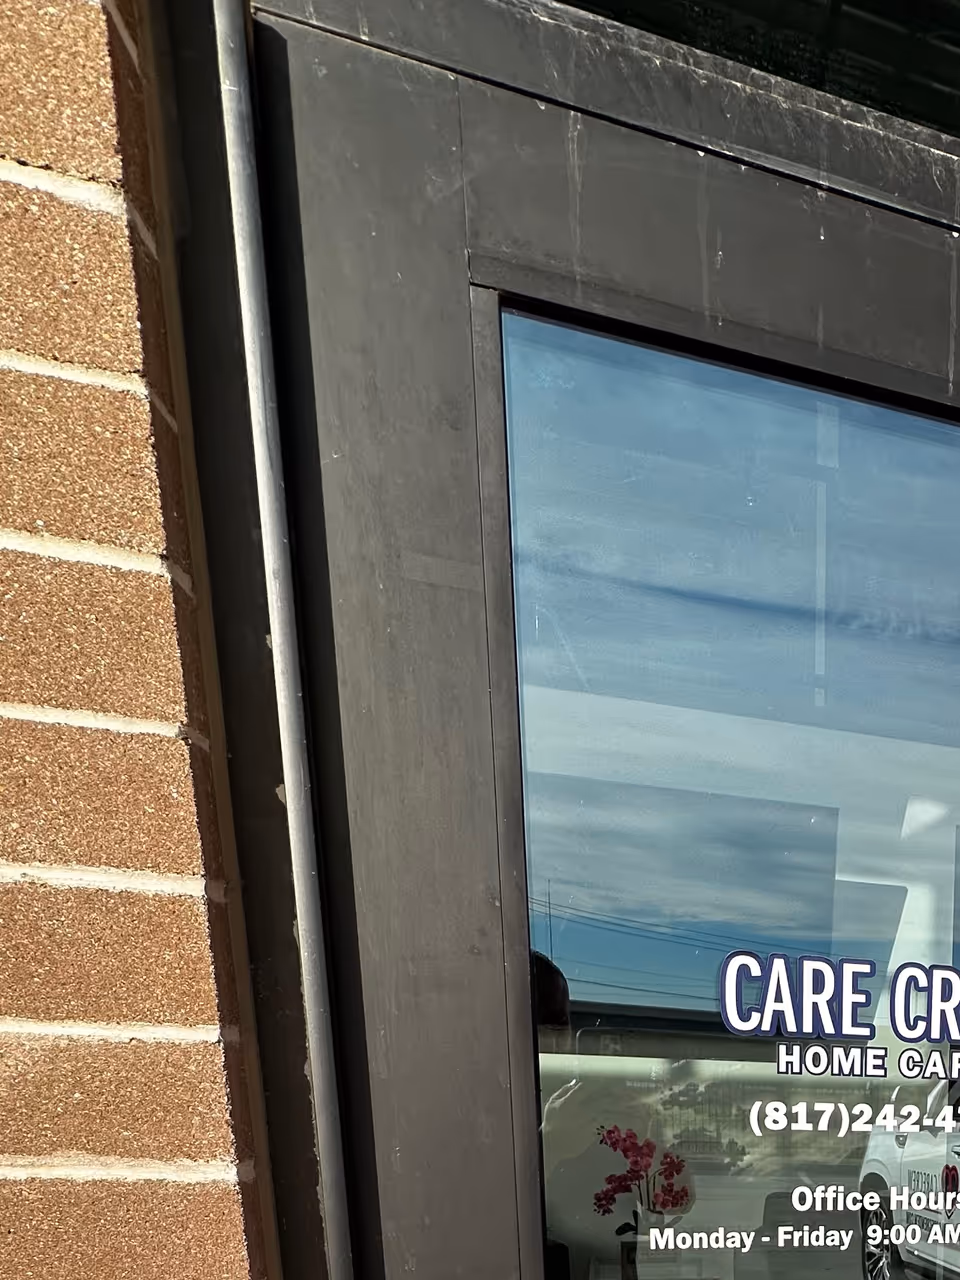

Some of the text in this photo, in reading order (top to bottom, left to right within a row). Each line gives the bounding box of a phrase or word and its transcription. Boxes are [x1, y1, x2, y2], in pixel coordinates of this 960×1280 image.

[721, 950, 875, 1040] CARE
[777, 1044, 887, 1077] HOME
[791, 1185, 881, 1212] Office
[649, 1227, 755, 1252] Monday
[777, 1225, 853, 1250] Friday
[867, 1225, 921, 1245] 9:00
